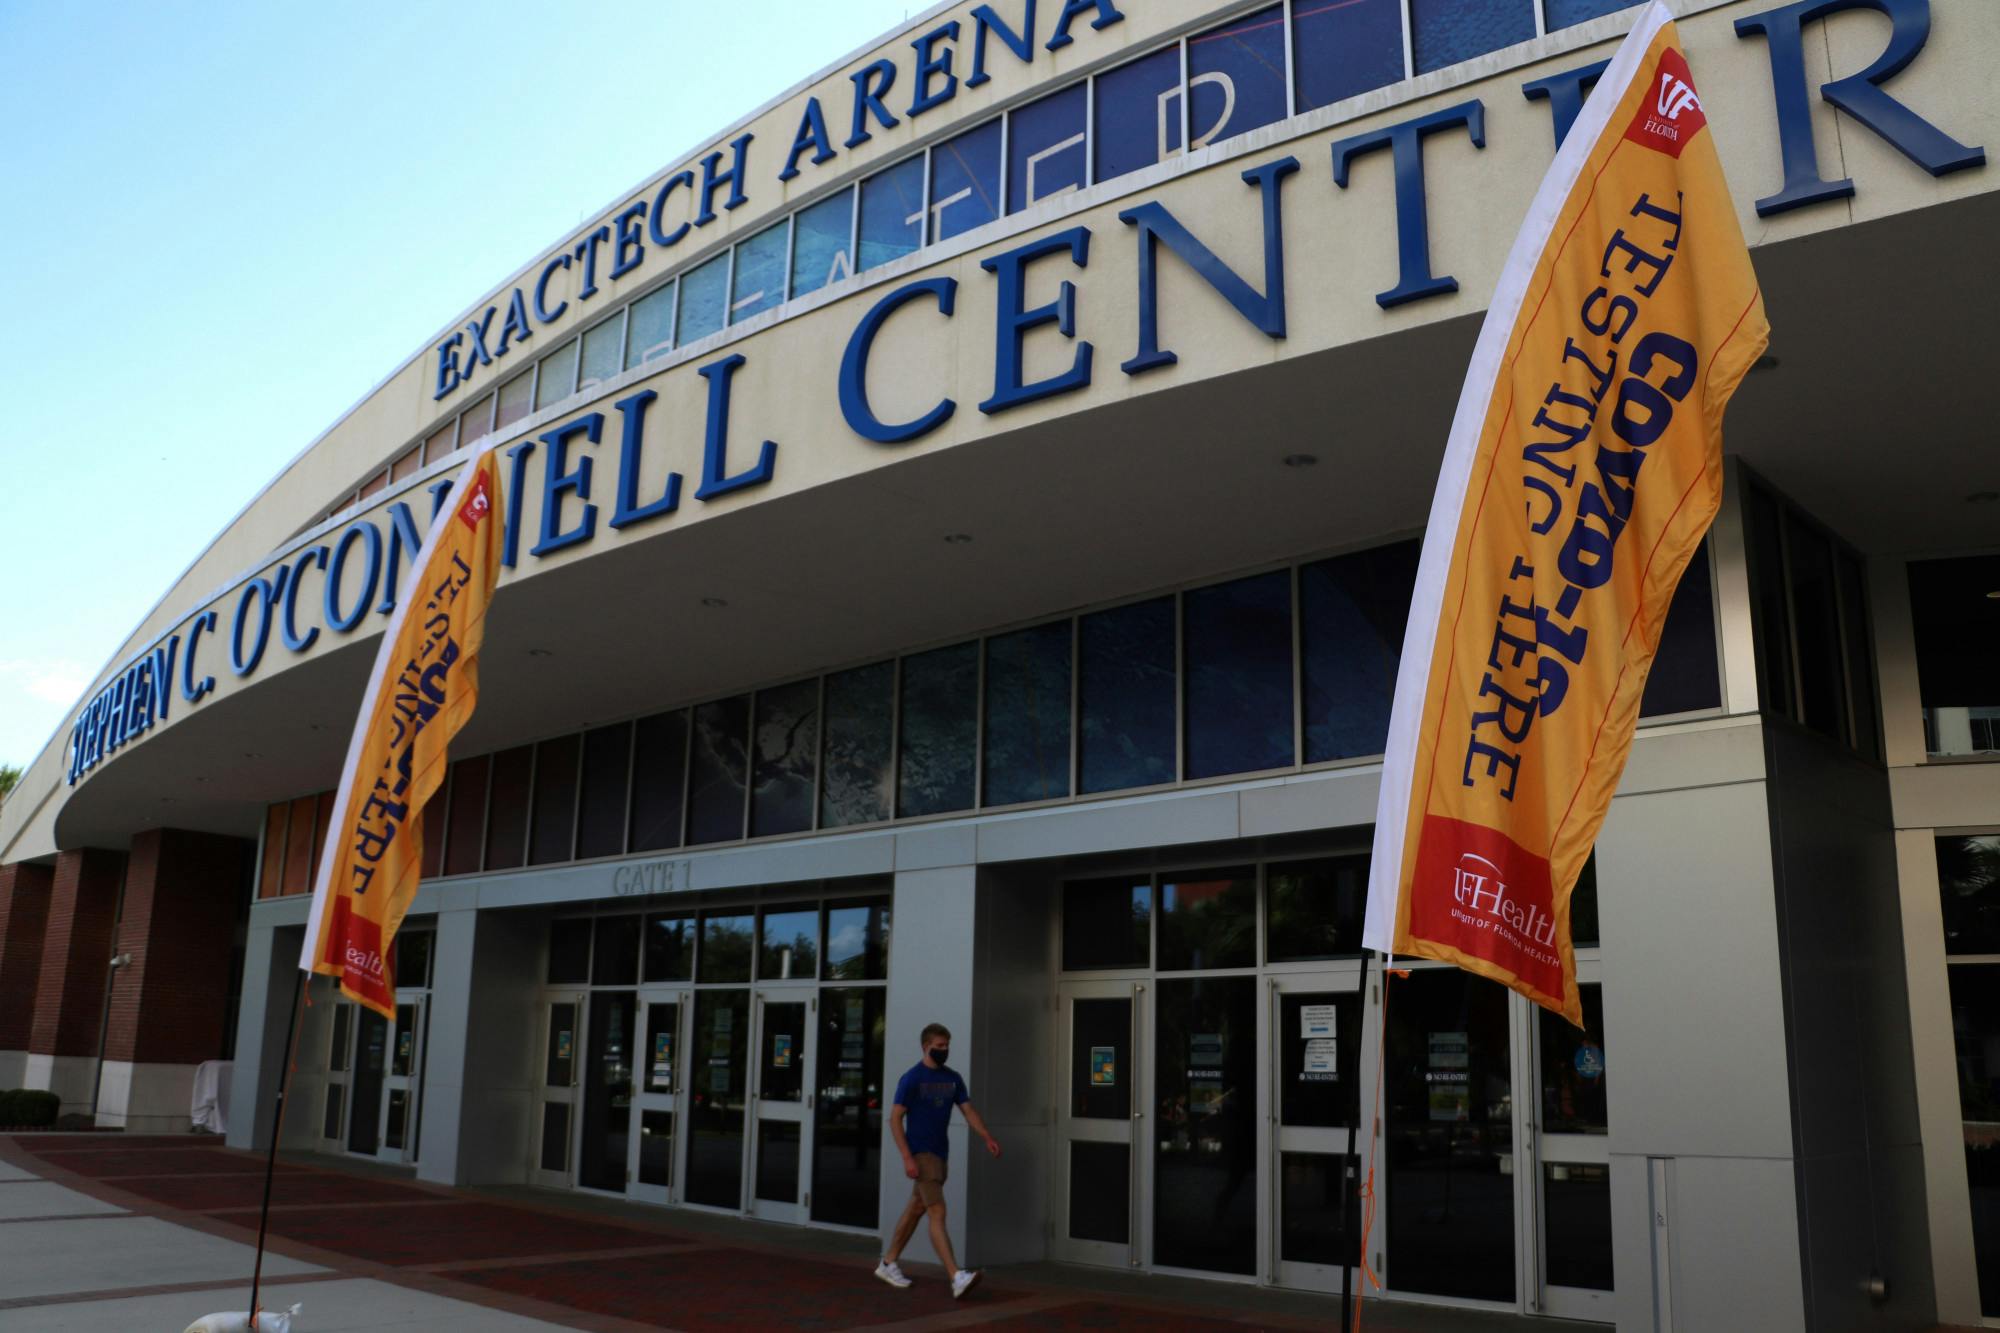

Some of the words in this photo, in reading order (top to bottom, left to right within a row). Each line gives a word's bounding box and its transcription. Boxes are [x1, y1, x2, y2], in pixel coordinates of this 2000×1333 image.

[1657, 72, 1704, 120] UF
[432, 133, 754, 402] EXACTECH
[67, 634, 181, 787] STEPHEN
[613, 861, 675, 897] GATE
[682, 860, 694, 891] 1
[1476, 918, 1490, 929] OF
[1493, 923, 1522, 950] FLORIDA
[1523, 944, 1560, 968] HEALTH
